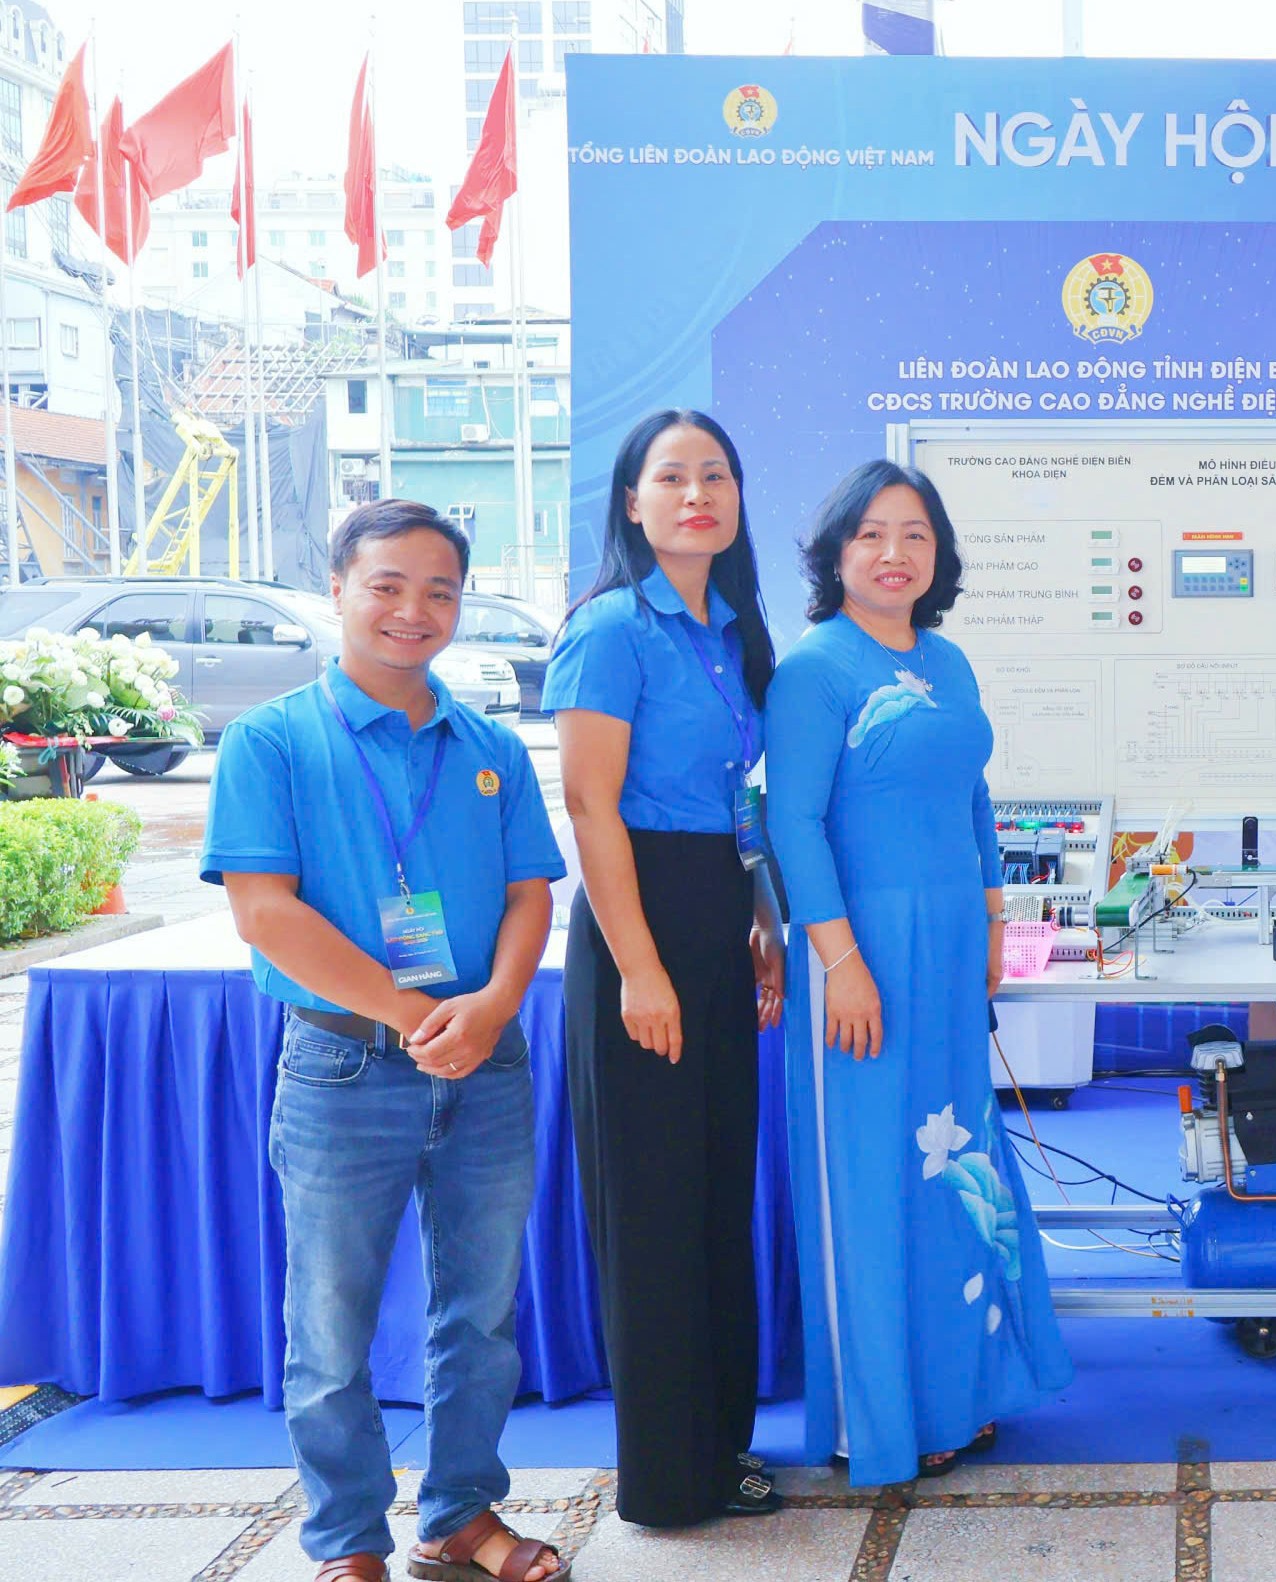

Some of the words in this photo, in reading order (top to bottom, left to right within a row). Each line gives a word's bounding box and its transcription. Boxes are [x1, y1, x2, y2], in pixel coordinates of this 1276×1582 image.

[954, 98, 1144, 168] NGÀY
[568, 141, 624, 164] TỔNG
[630, 143, 668, 164] LIÊN
[674, 143, 731, 165] ĐOÀN
[737, 147, 775, 165] LAO
[781, 146, 840, 169] ĐỘNG
[845, 146, 886, 169] VIỆT
[892, 149, 934, 167] NAM
[899, 357, 943, 378] LIÊN
[951, 357, 1017, 378] ĐOÀN
[1026, 361, 1069, 378] LAO
[1077, 357, 1146, 384] ĐỘNG
[1153, 355, 1202, 378] TỈNH
[1211, 357, 1261, 384] ĐIỆN
[868, 393, 932, 411] CĐCS
[939, 388, 1032, 411] TRƯỜNG
[1040, 393, 1090, 411] CAO
[1098, 384, 1165, 411] ĐẲNG
[1173, 384, 1234, 411] NGHỀ
[995, 457, 1016, 466] CAO
[1199, 459, 1216, 470] MÔ
[1219, 459, 1247, 470] HÌNH
[1012, 470, 1040, 479] KHOA
[1178, 474, 1194, 486] VÀ
[1231, 475, 1258, 488] LOẠI
[1017, 561, 1039, 571] CAO
[1018, 590, 1052, 599] TRUNG
[398, 974, 419, 984] GIAN
[419, 970, 442, 980] HÀNG
